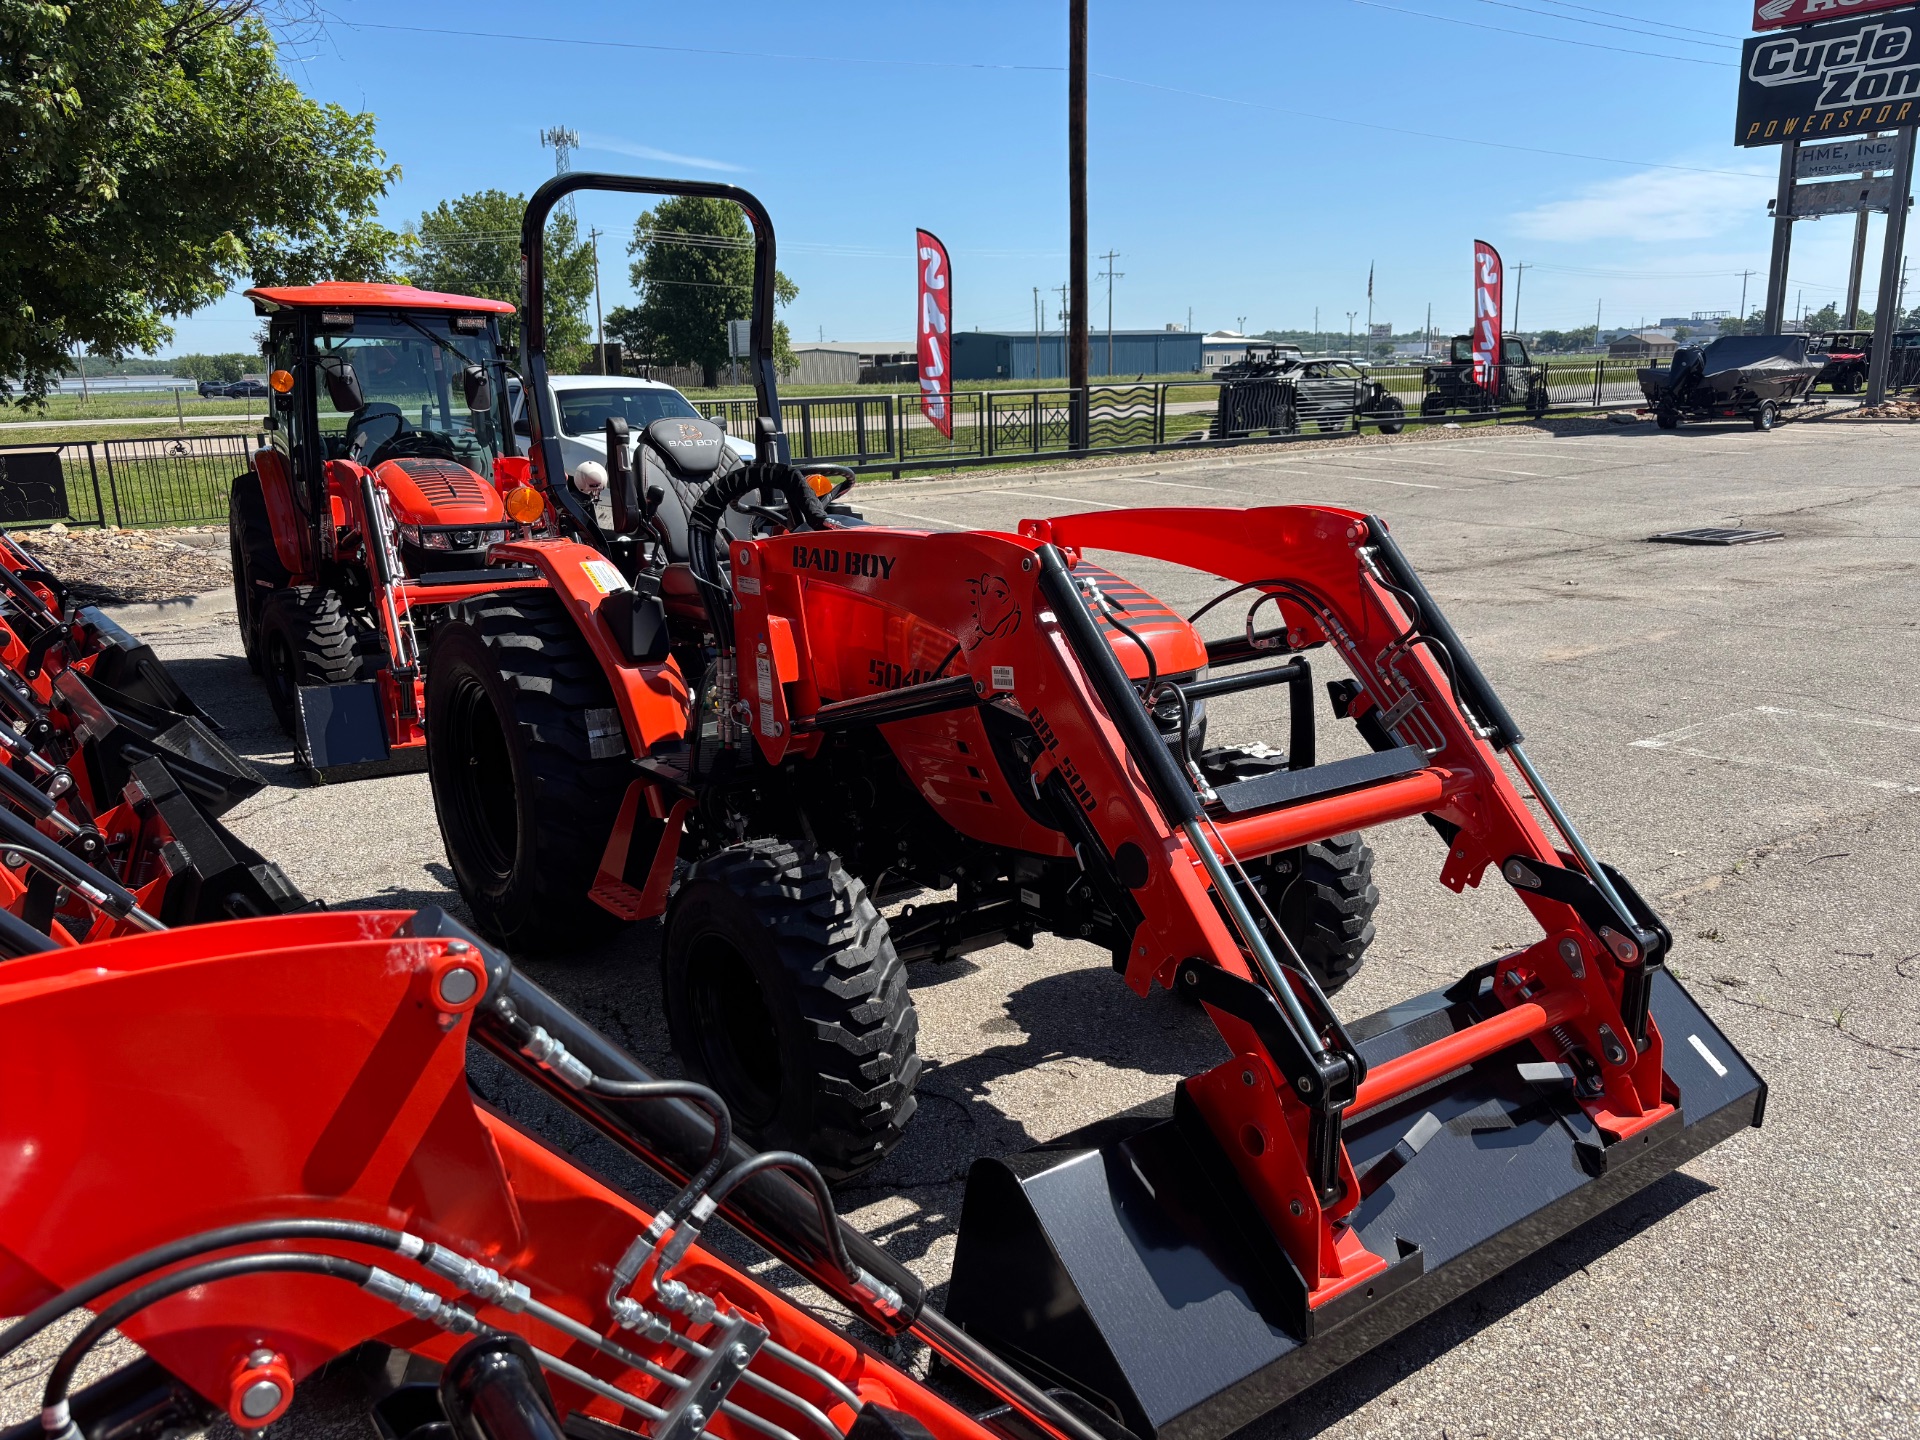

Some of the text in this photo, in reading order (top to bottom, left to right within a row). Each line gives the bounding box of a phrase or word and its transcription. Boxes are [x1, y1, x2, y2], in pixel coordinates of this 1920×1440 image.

[1750, 24, 1911, 84] Cycle
[1815, 63, 1920, 110] Zon
[1746, 101, 1920, 139] POWERSPOR
[1802, 143, 1892, 161] HME, INC.
[1809, 159, 1882, 172] METAL SALES
[697, 439, 719, 447] BOY
[792, 545, 896, 580] BAD BOY
[1058, 756, 1098, 812] 500
[694, 1177, 707, 1191] EN
